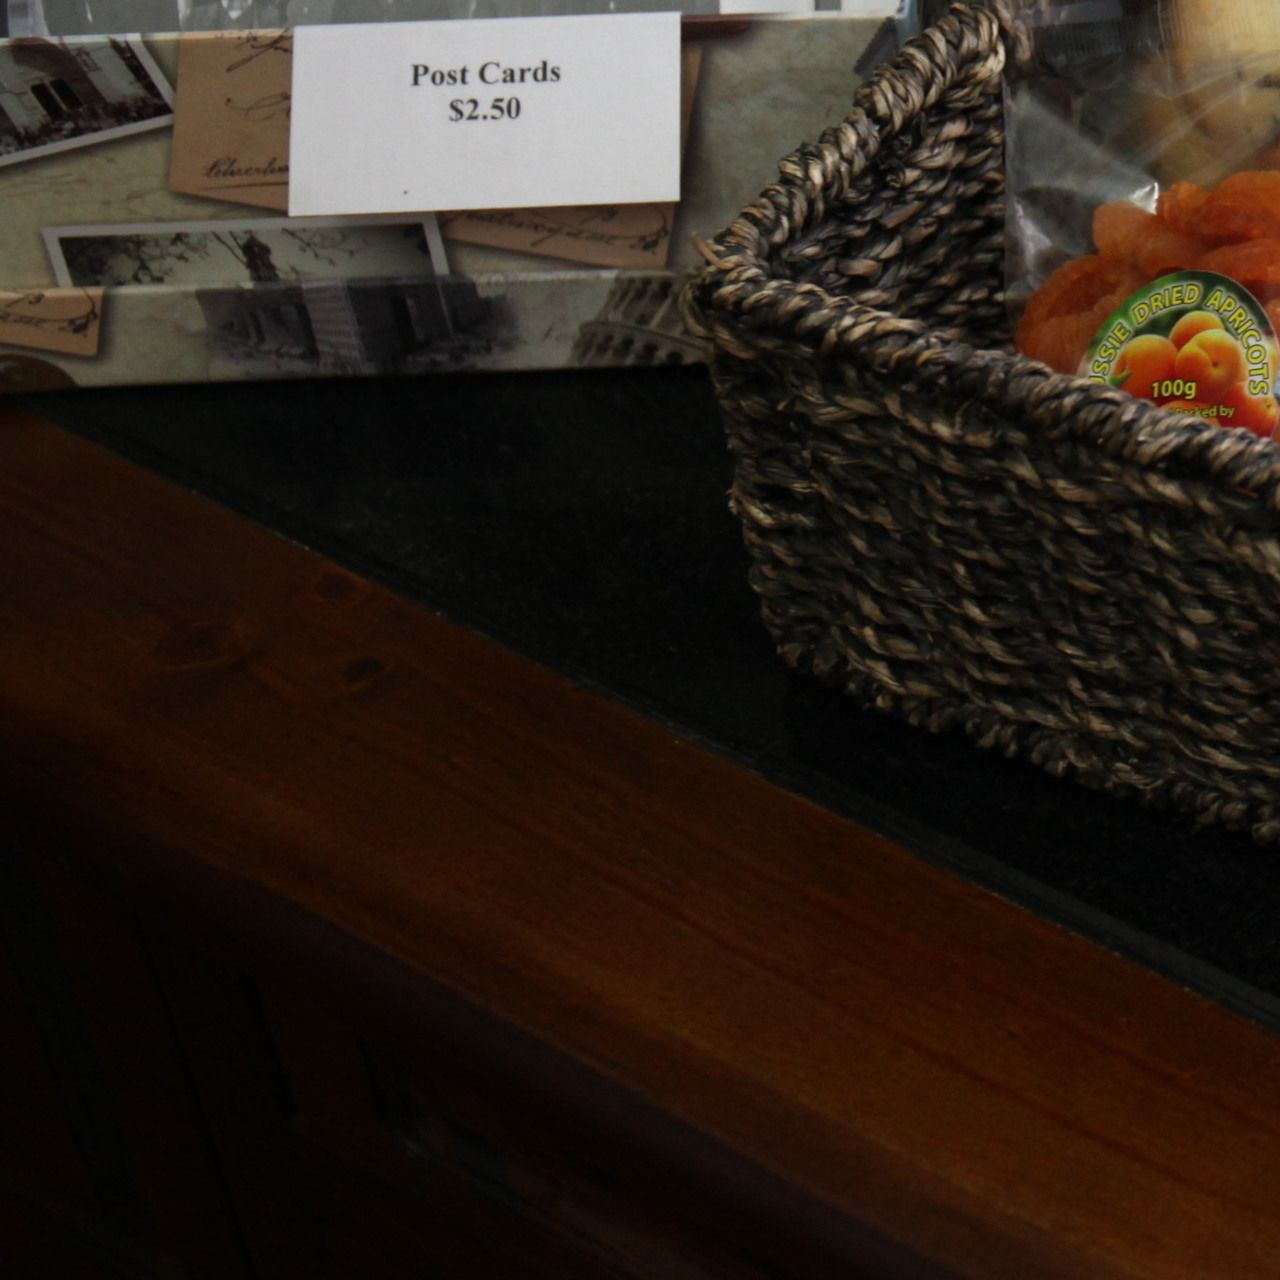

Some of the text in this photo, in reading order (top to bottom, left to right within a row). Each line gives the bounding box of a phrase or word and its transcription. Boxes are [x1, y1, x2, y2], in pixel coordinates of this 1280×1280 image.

[410, 60, 561, 87] Post Cards
[448, 97, 522, 122] $2.50
[1089, 283, 1270, 396] SSIE DRIED APRICOTS
[1152, 379, 1197, 400] 100g
[1220, 404, 1235, 418] by
